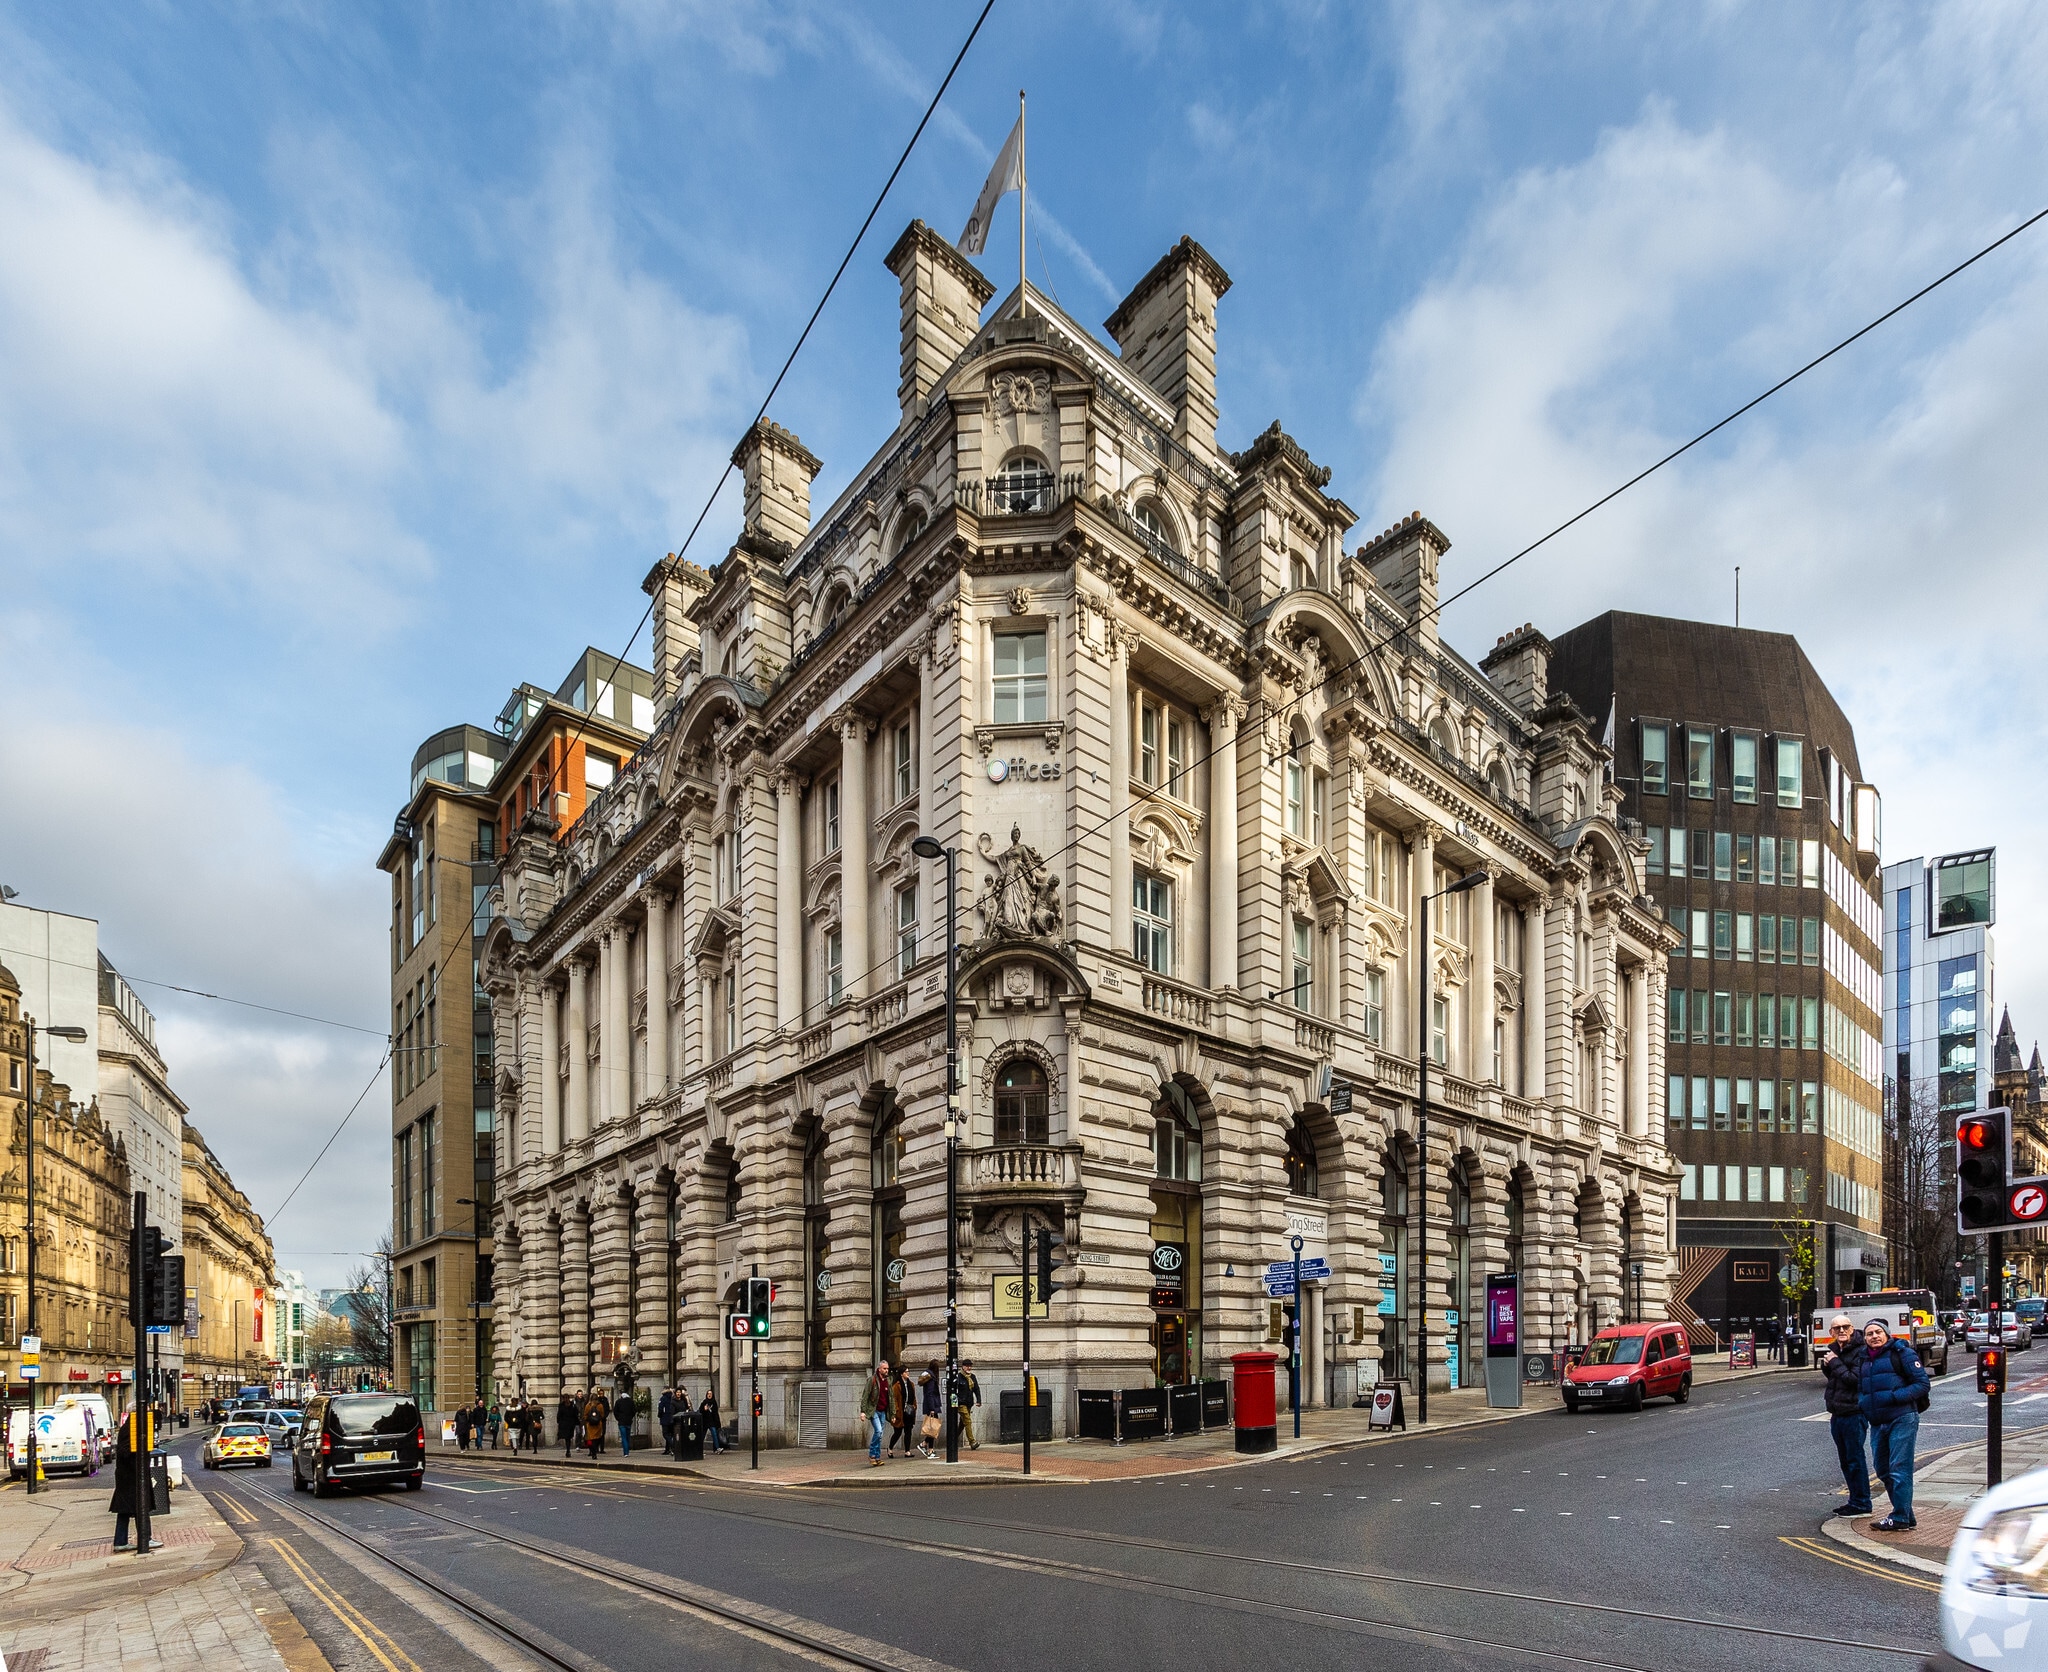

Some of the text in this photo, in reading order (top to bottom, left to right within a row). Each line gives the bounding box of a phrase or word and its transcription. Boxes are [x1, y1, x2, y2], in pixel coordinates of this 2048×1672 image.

[988, 757, 1061, 784] Offices
[1105, 969, 1117, 979] KING
[1102, 976, 1119, 987] STREET
[1303, 1217, 1325, 1234] Street
[1385, 1260, 1394, 1269] LET
[1739, 1267, 1765, 1276] KALA
